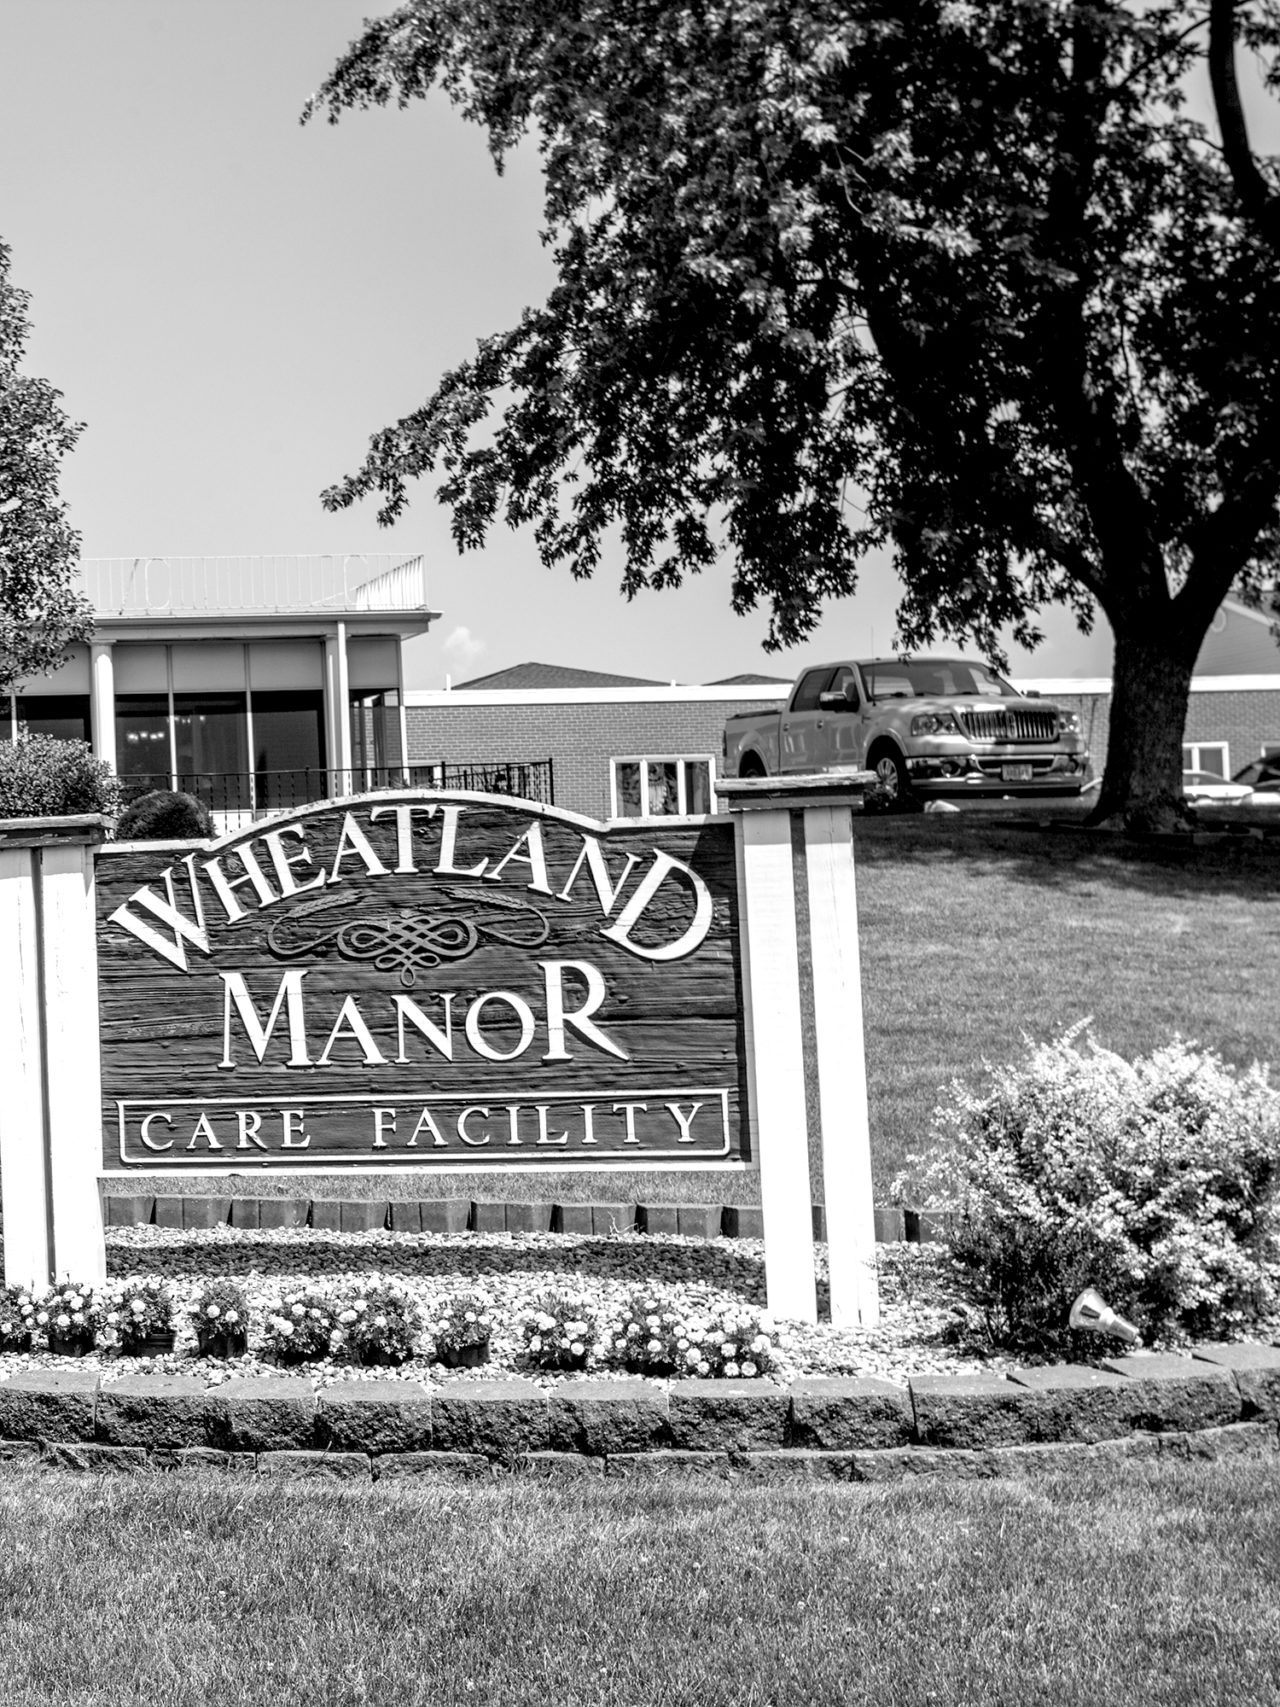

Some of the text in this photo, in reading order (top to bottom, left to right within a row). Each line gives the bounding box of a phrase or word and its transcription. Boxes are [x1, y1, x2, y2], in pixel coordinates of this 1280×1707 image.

[107, 803, 714, 973] WHEATLAND
[218, 961, 629, 1068] MANOR
[140, 1103, 704, 1151] CARE FACILITY
